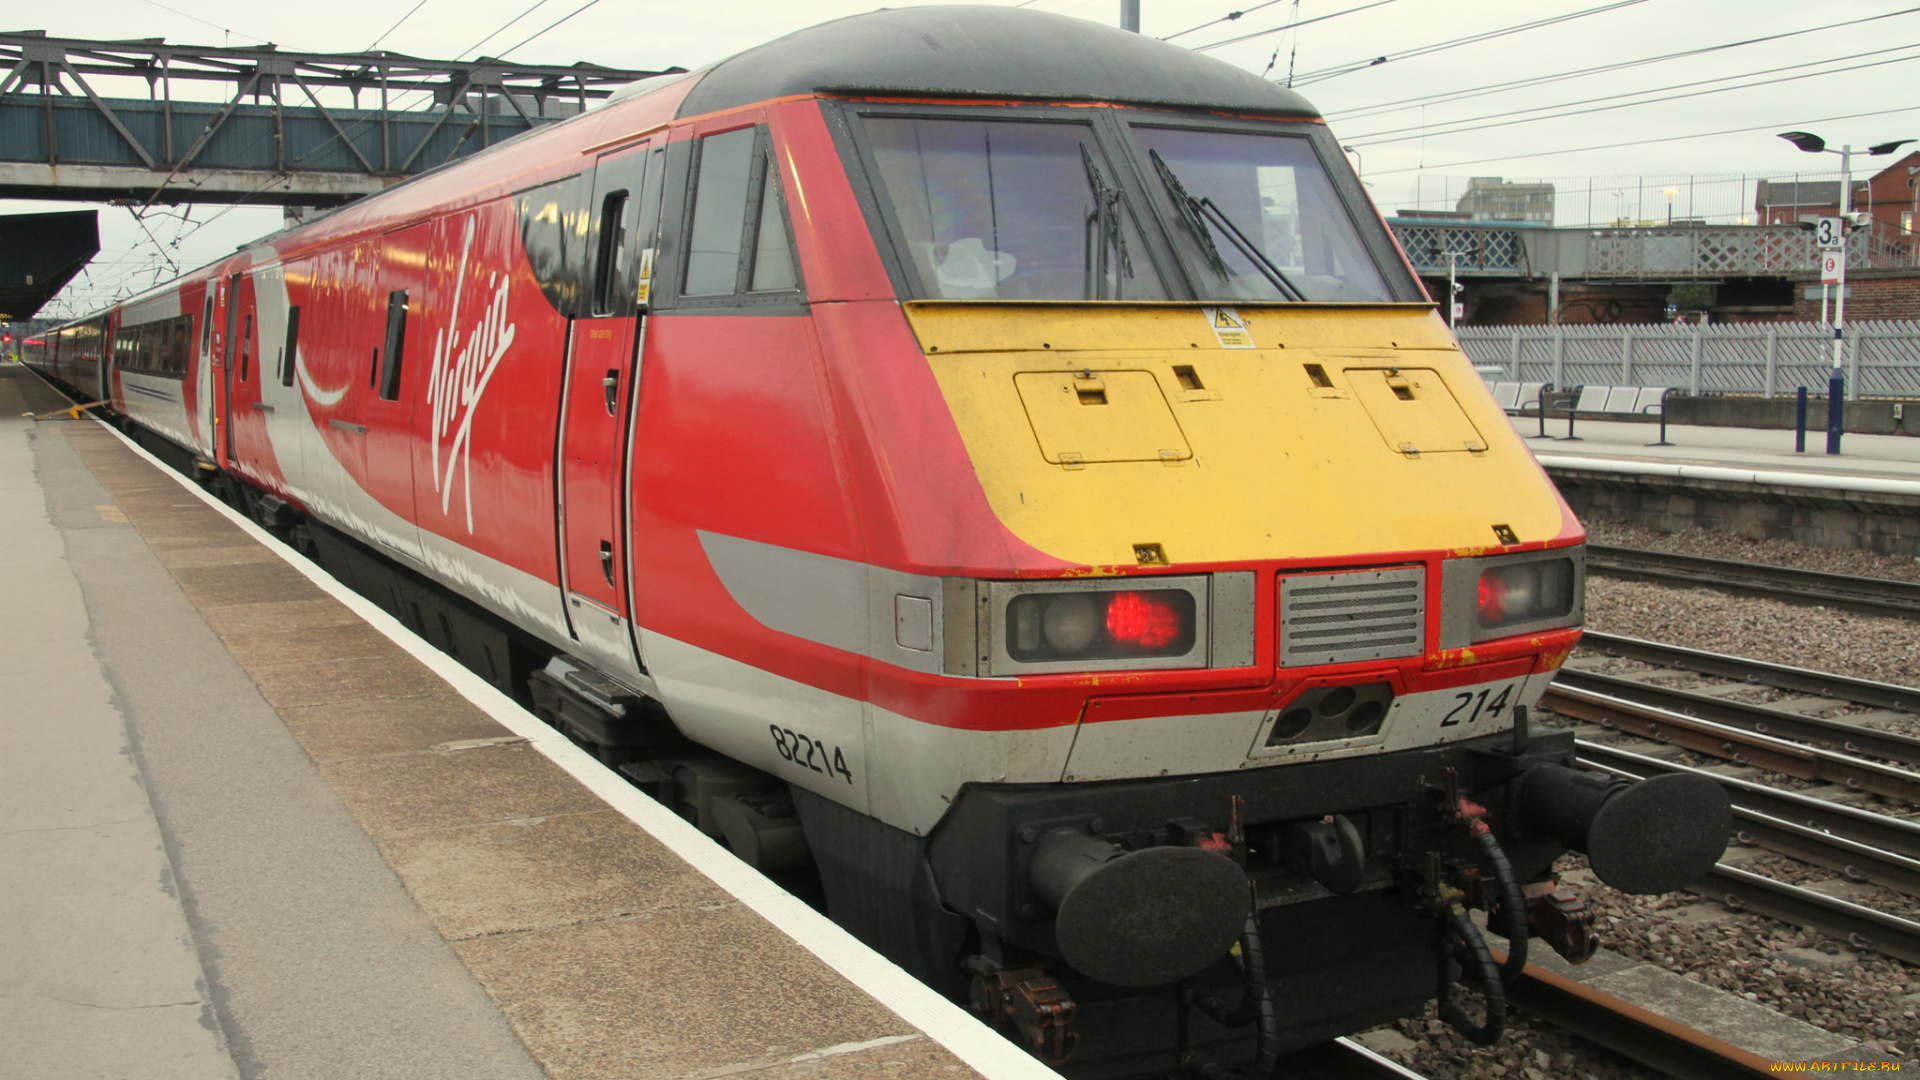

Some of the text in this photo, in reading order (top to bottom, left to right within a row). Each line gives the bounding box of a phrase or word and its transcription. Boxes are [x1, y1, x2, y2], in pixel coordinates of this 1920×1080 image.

[427, 213, 515, 535] Virgin
[1440, 683, 1515, 728] 214
[769, 724, 853, 786] 82214
